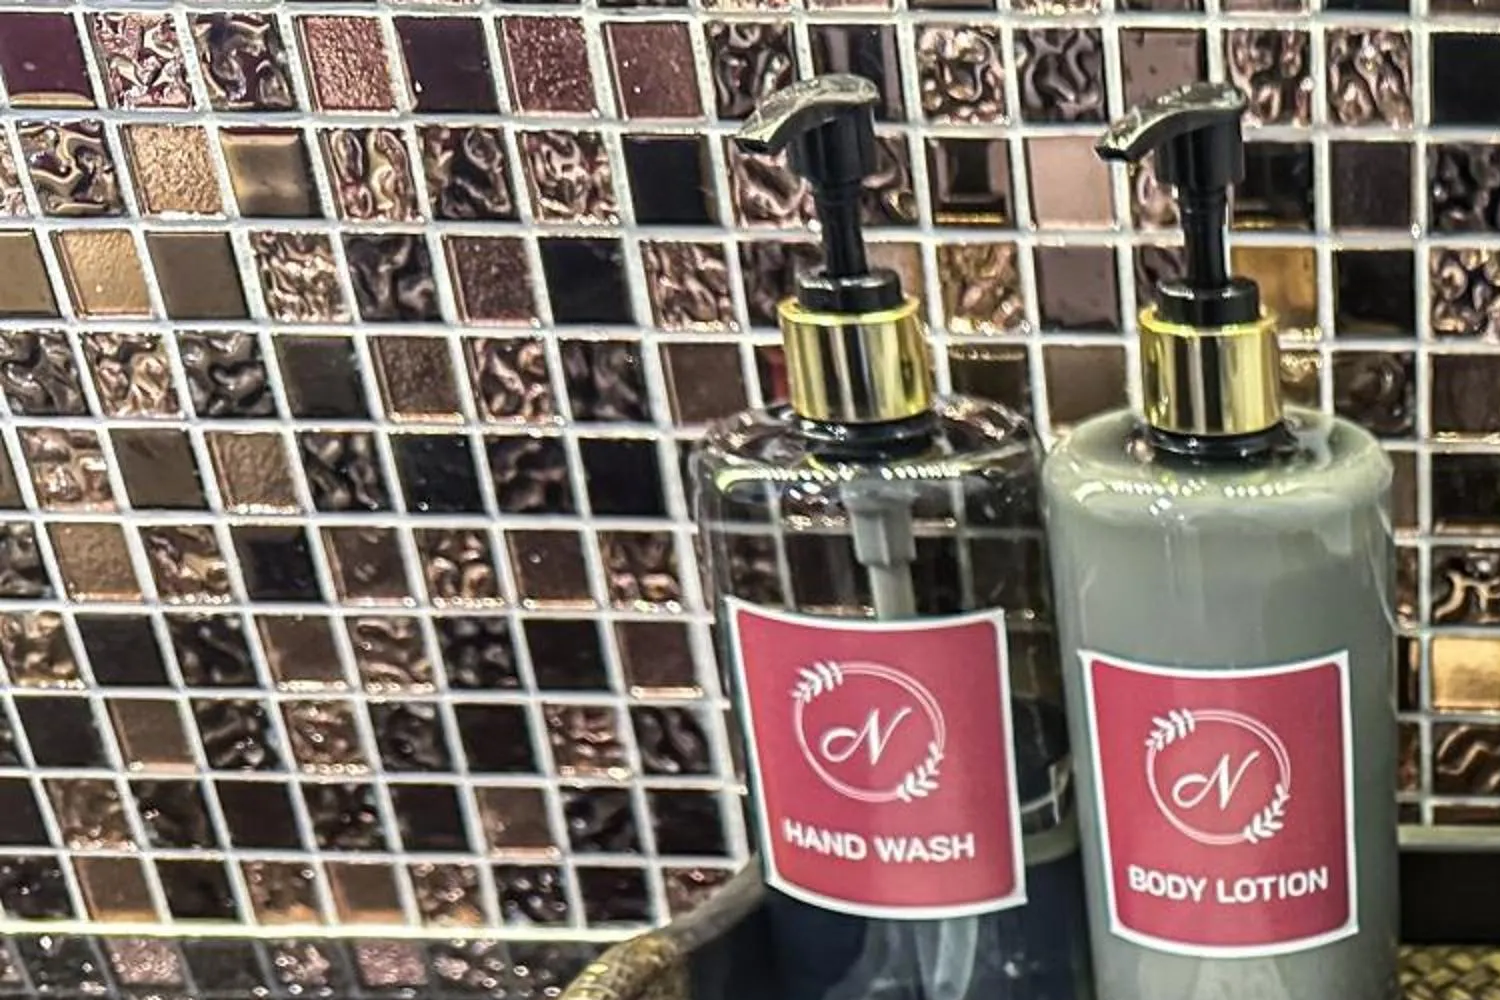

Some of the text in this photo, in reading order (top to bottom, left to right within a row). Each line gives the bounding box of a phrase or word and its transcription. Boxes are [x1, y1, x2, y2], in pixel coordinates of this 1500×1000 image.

[821, 707, 912, 766] N
[1172, 751, 1260, 810] N
[782, 816, 975, 863] HAND WASH
[1128, 863, 1328, 904] BODY LOTION
